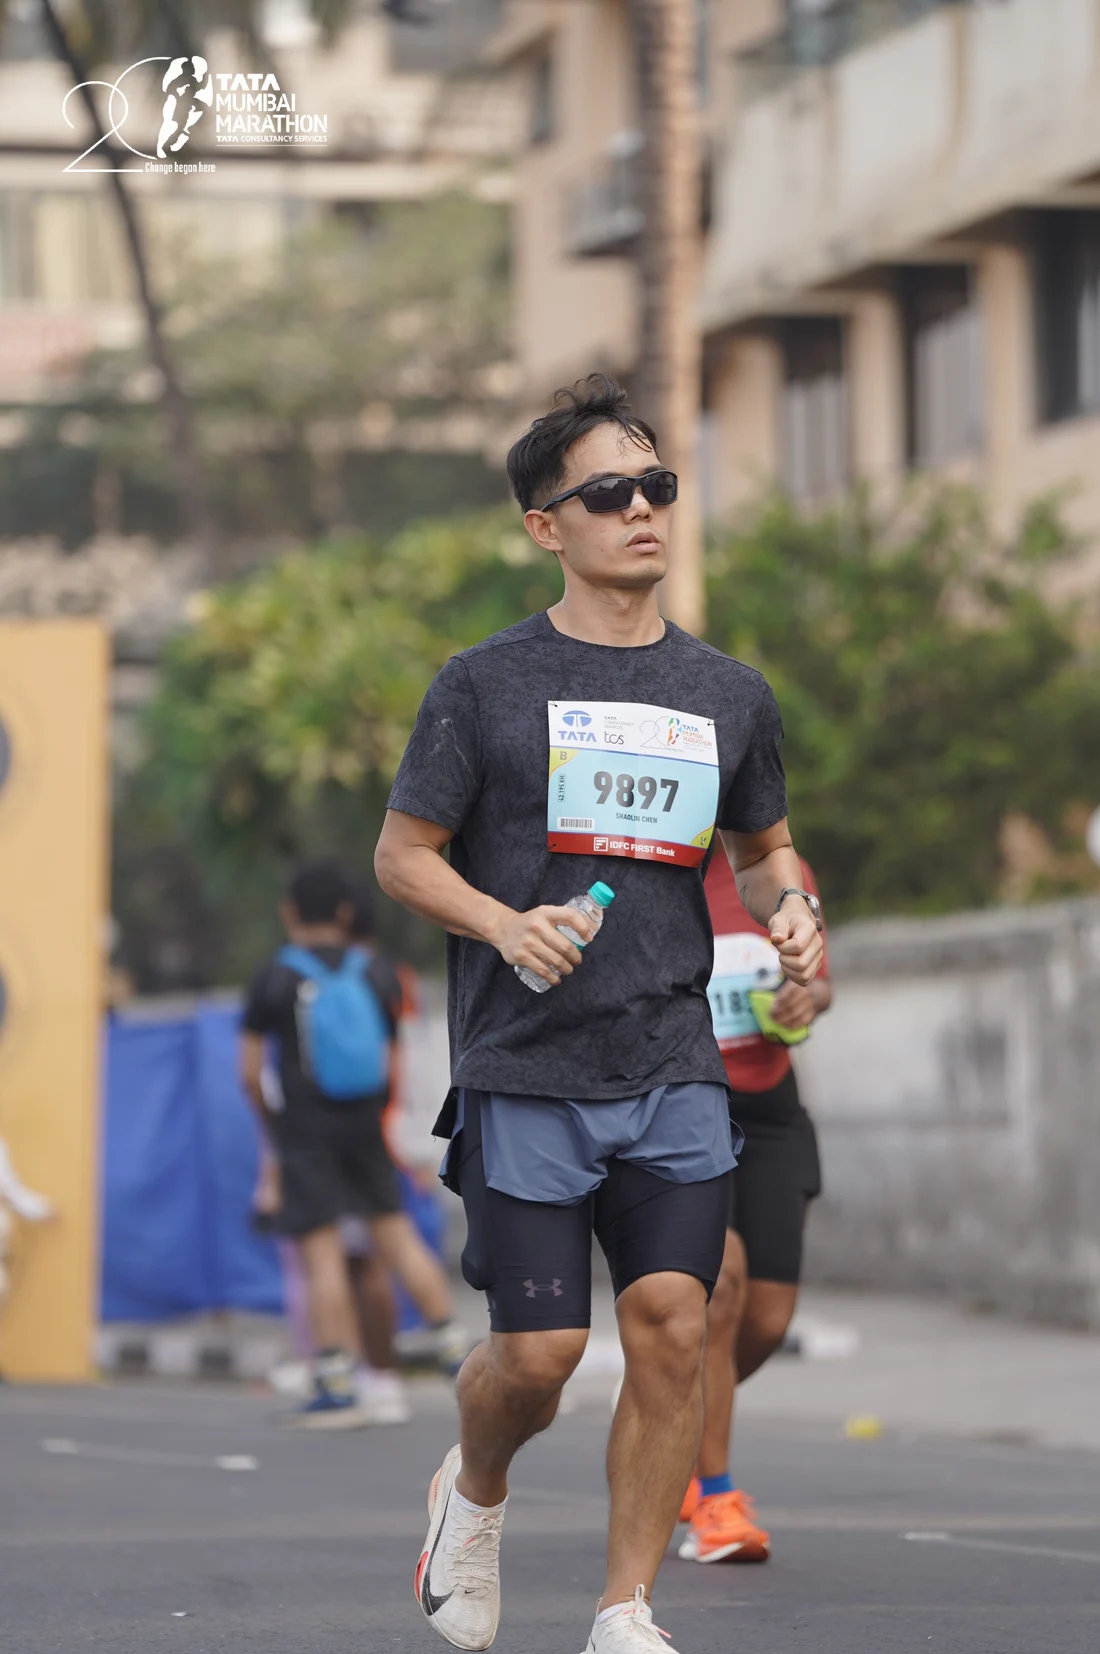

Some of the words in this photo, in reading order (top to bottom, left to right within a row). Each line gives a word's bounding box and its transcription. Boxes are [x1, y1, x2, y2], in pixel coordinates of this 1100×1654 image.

[682, 724, 699, 733] TATA
[558, 730, 597, 743] TATA
[603, 731, 625, 745] tcs
[559, 751, 568, 760] B
[593, 770, 679, 813] 9897
[615, 812, 640, 822] SHAOLIN
[641, 816, 658, 824] CHEN
[609, 841, 630, 850] IDFC
[631, 844, 655, 853] FIRST
[656, 846, 676, 857] Bank
